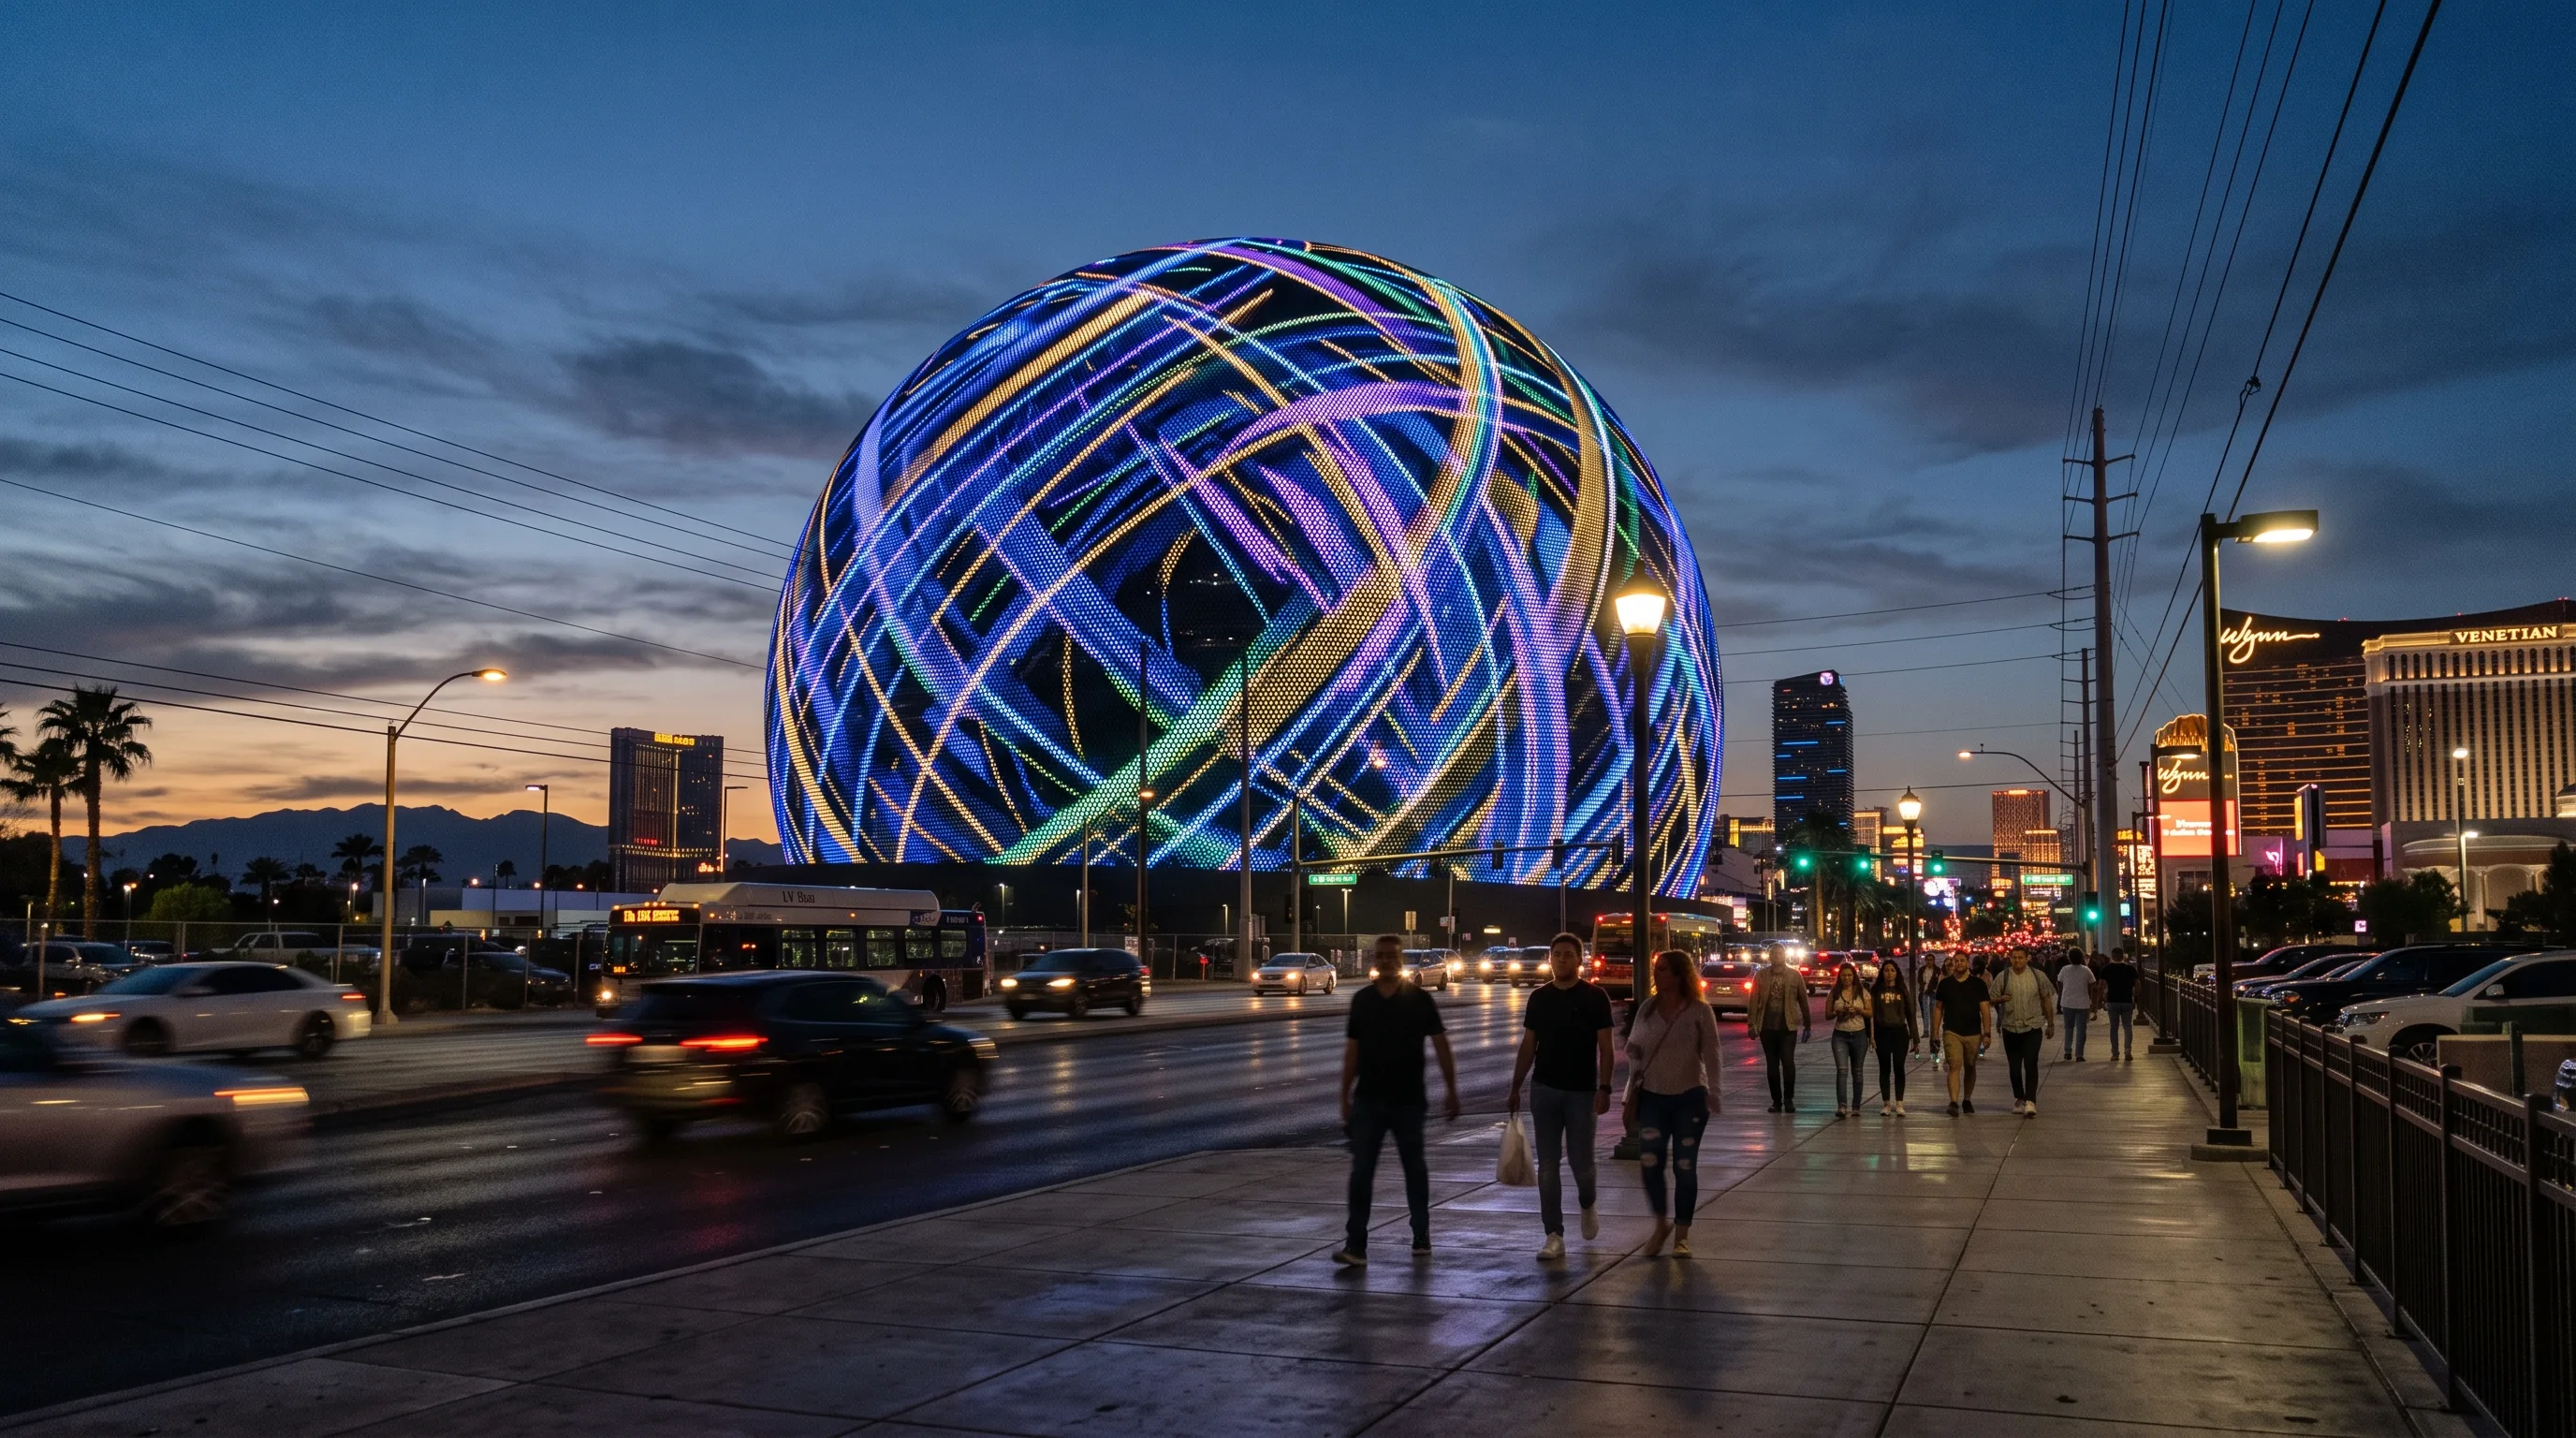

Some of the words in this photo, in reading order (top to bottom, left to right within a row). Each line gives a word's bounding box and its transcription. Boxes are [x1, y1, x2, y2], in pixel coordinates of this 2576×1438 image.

[2220, 616, 2320, 664] Wynn
[2454, 625, 2558, 643] VENETIAN
[2157, 759, 2233, 794] Wynn
[783, 890, 794, 902] LV
